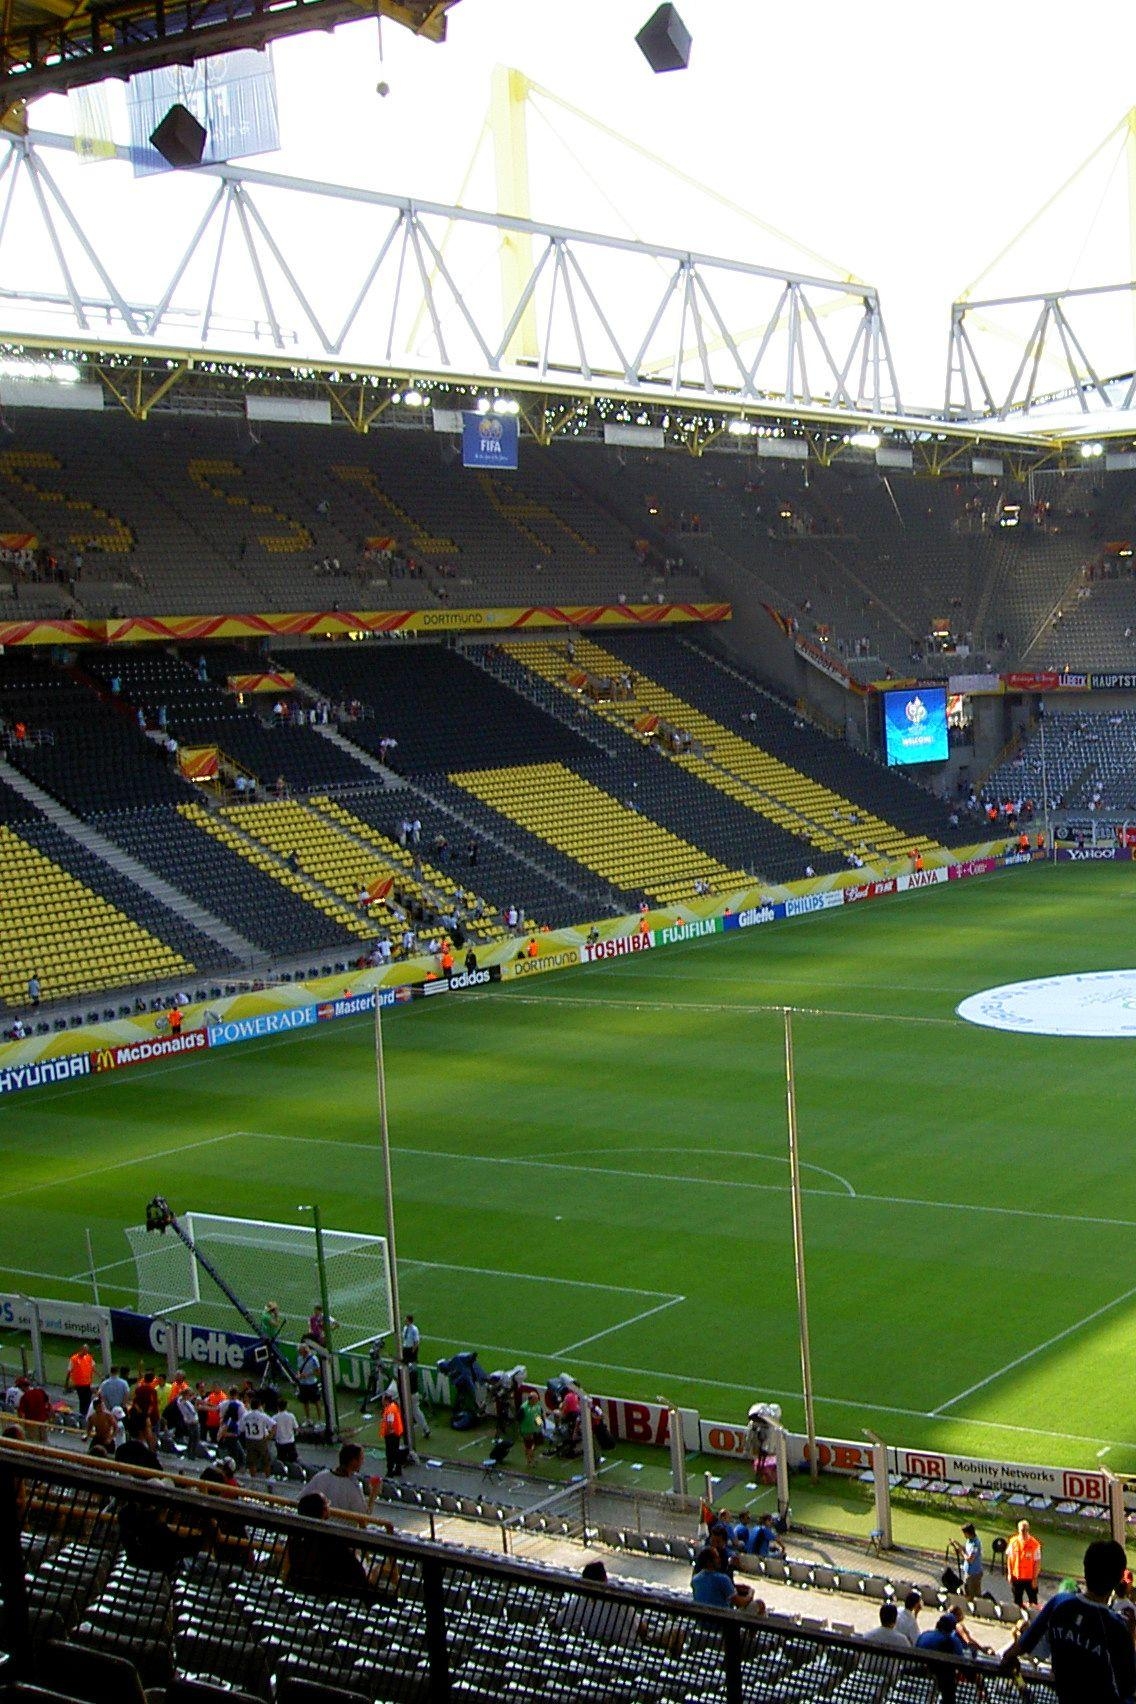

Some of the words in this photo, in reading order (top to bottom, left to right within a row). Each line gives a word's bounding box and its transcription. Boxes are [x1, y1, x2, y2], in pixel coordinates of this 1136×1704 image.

[480, 440, 501, 453] FIFA
[1067, 849, 1116, 860] YAHOO!
[908, 871, 939, 888] AVAYA
[738, 904, 775, 929] Gillette
[787, 896, 824, 916] PHILIPS
[662, 918, 716, 945] FUJIFILM
[585, 932, 651, 962] TOSHIBA
[514, 951, 578, 976] DORTMUND
[450, 968, 491, 991] adidas
[335, 989, 395, 1017] MasterCard
[211, 1009, 315, 1045] POWERADE
[117, 1032, 205, 1065] McDonald's
[0, 1052, 91, 1093] HYUNDAI
[150, 1319, 246, 1369] Gllette
[245, 1422, 260, 1436] 13
[952, 1460, 999, 1478] Mobility
[1001, 1466, 1056, 1483] Networks
[1068, 1476, 1102, 1500] DB
[1052, 1627, 1101, 1657] ITALIA
